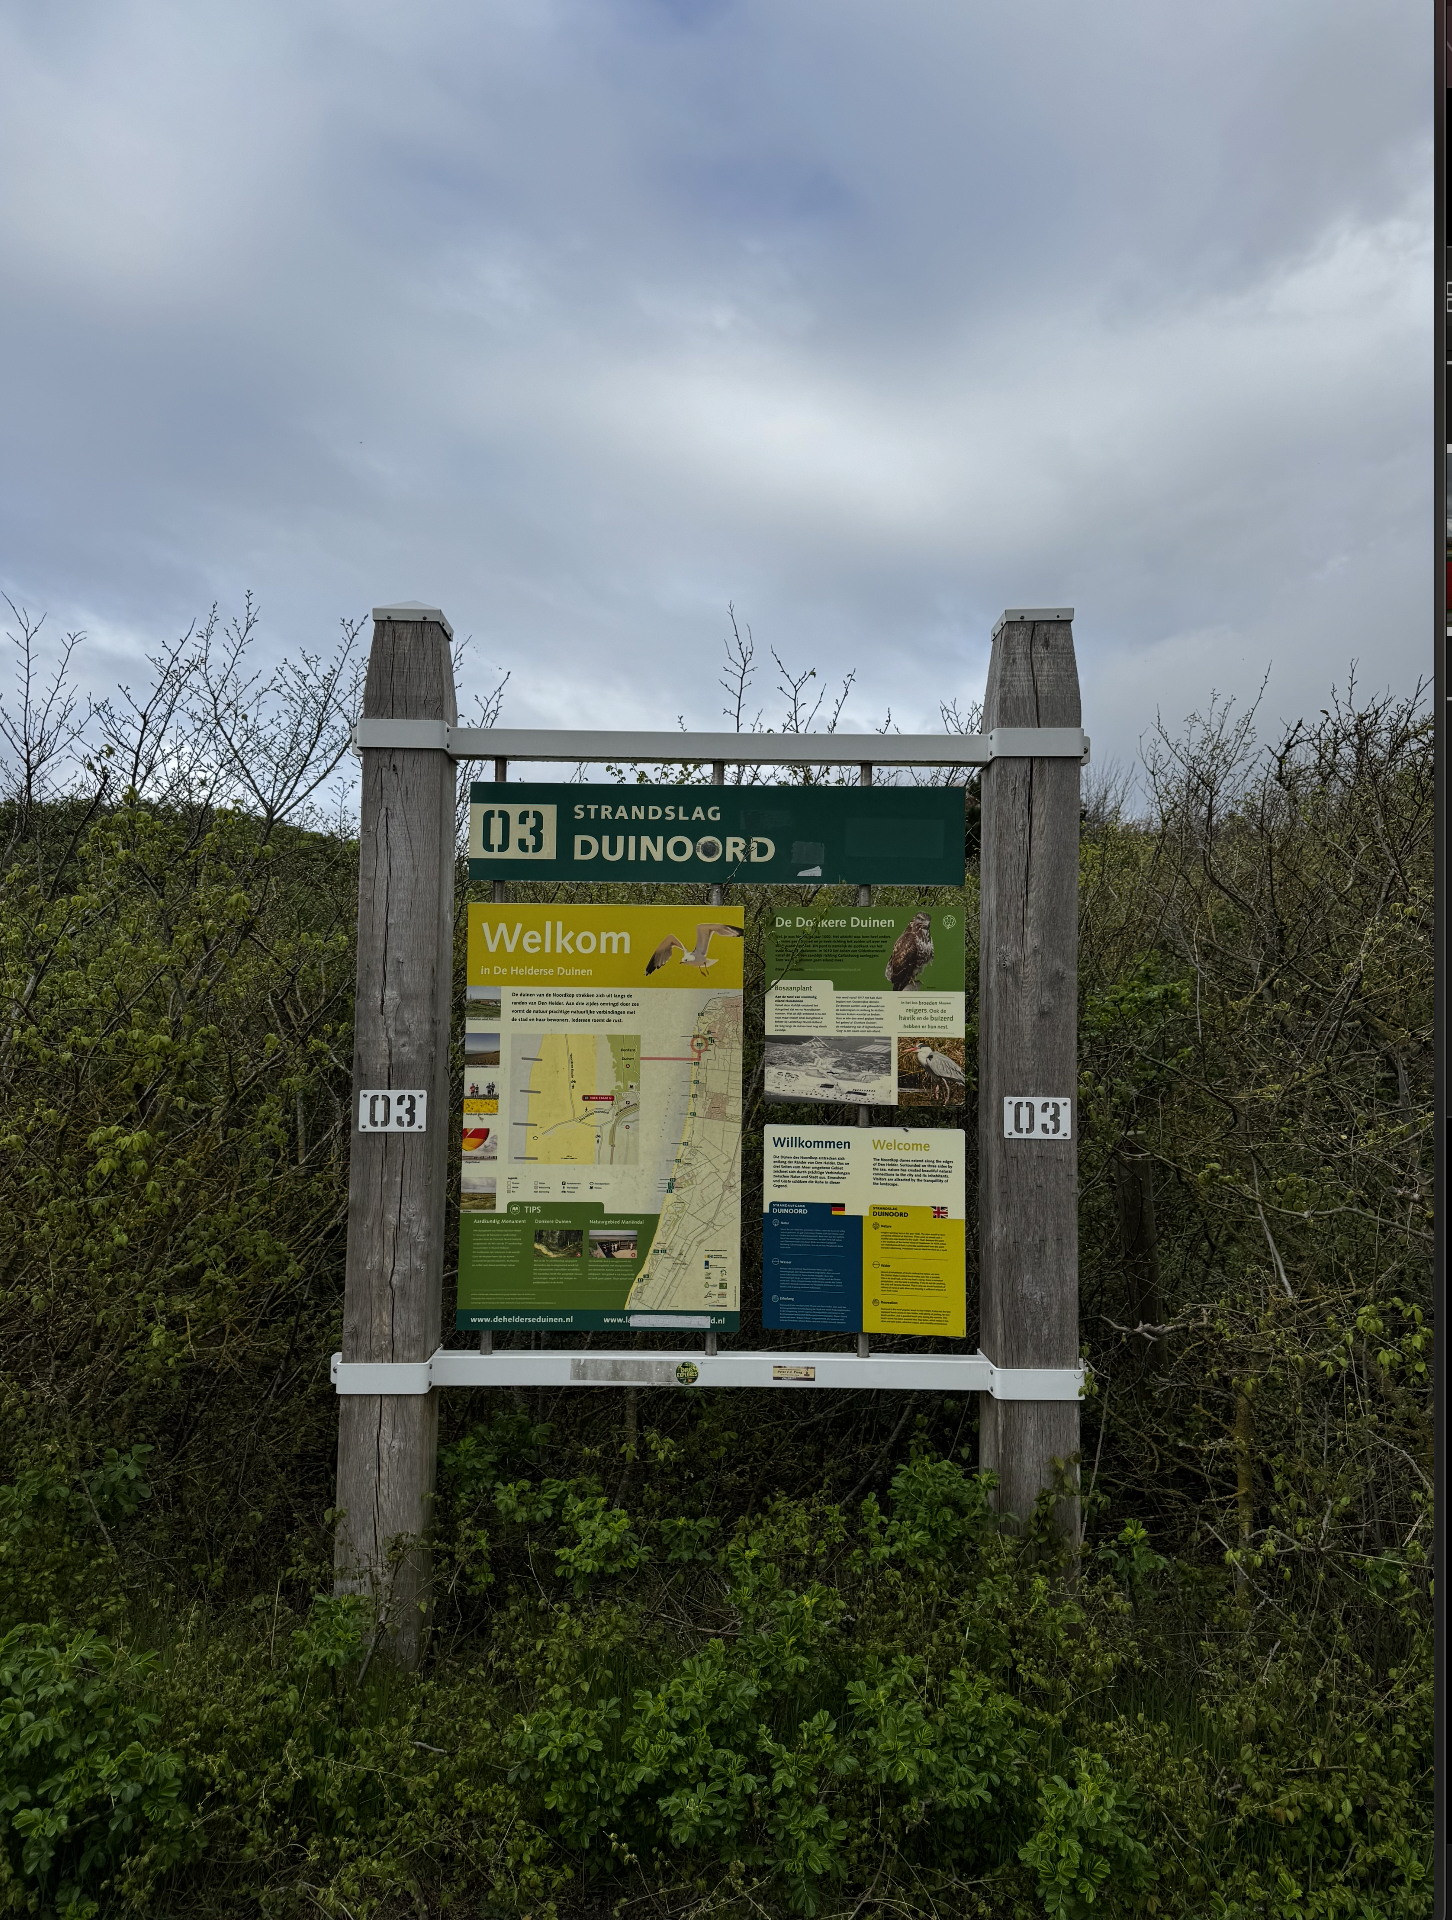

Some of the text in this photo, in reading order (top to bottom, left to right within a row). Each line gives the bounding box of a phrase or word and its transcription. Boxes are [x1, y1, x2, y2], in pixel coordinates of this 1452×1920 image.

[573, 804, 721, 821] STRANDSLAG
[482, 809, 544, 854] 03
[574, 834, 775, 862] DUINOORD
[775, 916, 792, 928] De
[851, 916, 895, 928] Duinen
[482, 920, 631, 954] Welkom
[480, 965, 593, 977] in De Helderse Duinen
[369, 1094, 416, 1128] 03
[1014, 1101, 1061, 1134] 03
[772, 1136, 851, 1150] Willkommen
[872, 1138, 931, 1152] Welcome
